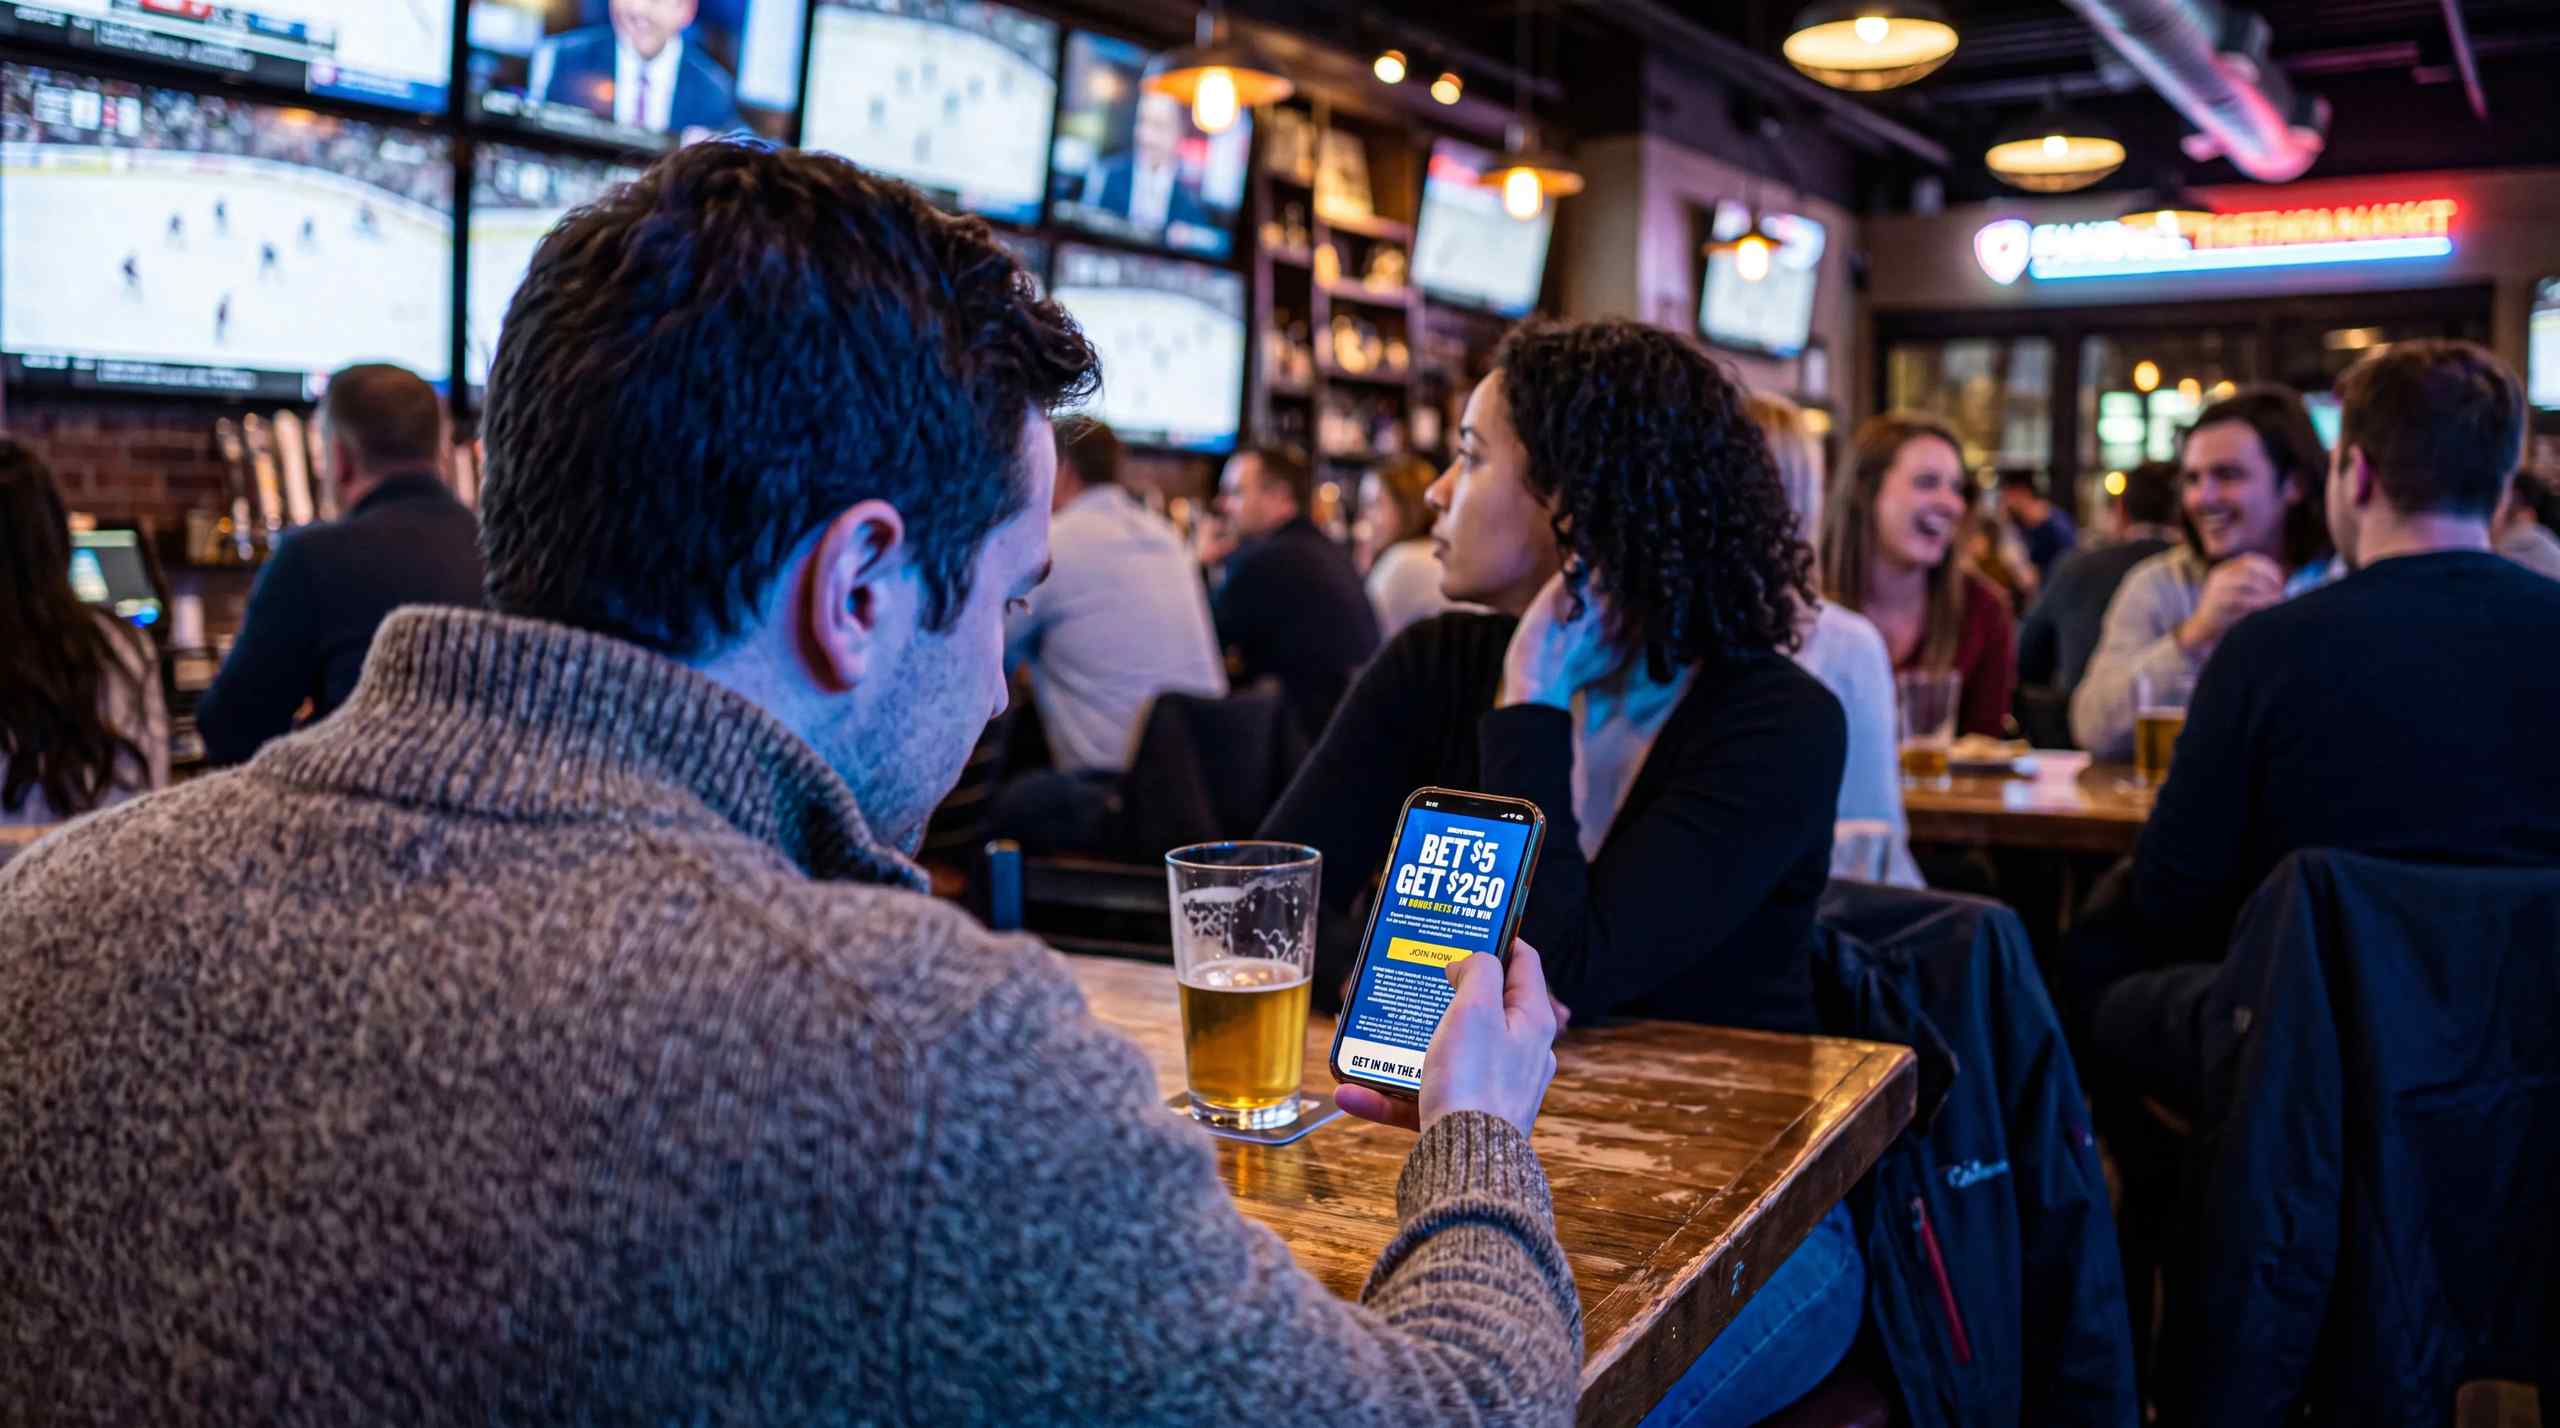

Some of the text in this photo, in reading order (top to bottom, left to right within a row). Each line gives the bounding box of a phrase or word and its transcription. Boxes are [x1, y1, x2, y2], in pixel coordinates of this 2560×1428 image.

[1419, 833, 1499, 873] BET $5
[1395, 864, 1505, 909] GET $250
[1398, 897, 1407, 906] IN
[1452, 905, 1461, 915] IF
[1461, 907, 1476, 918] YOU
[1477, 909, 1492, 920] WIN
[1409, 949, 1452, 961] JOIN NOW
[1352, 1056, 1370, 1068] GET
[1370, 1059, 1381, 1071] IN
[1382, 1062, 1396, 1073] ON
[1397, 1064, 1415, 1077] THE
